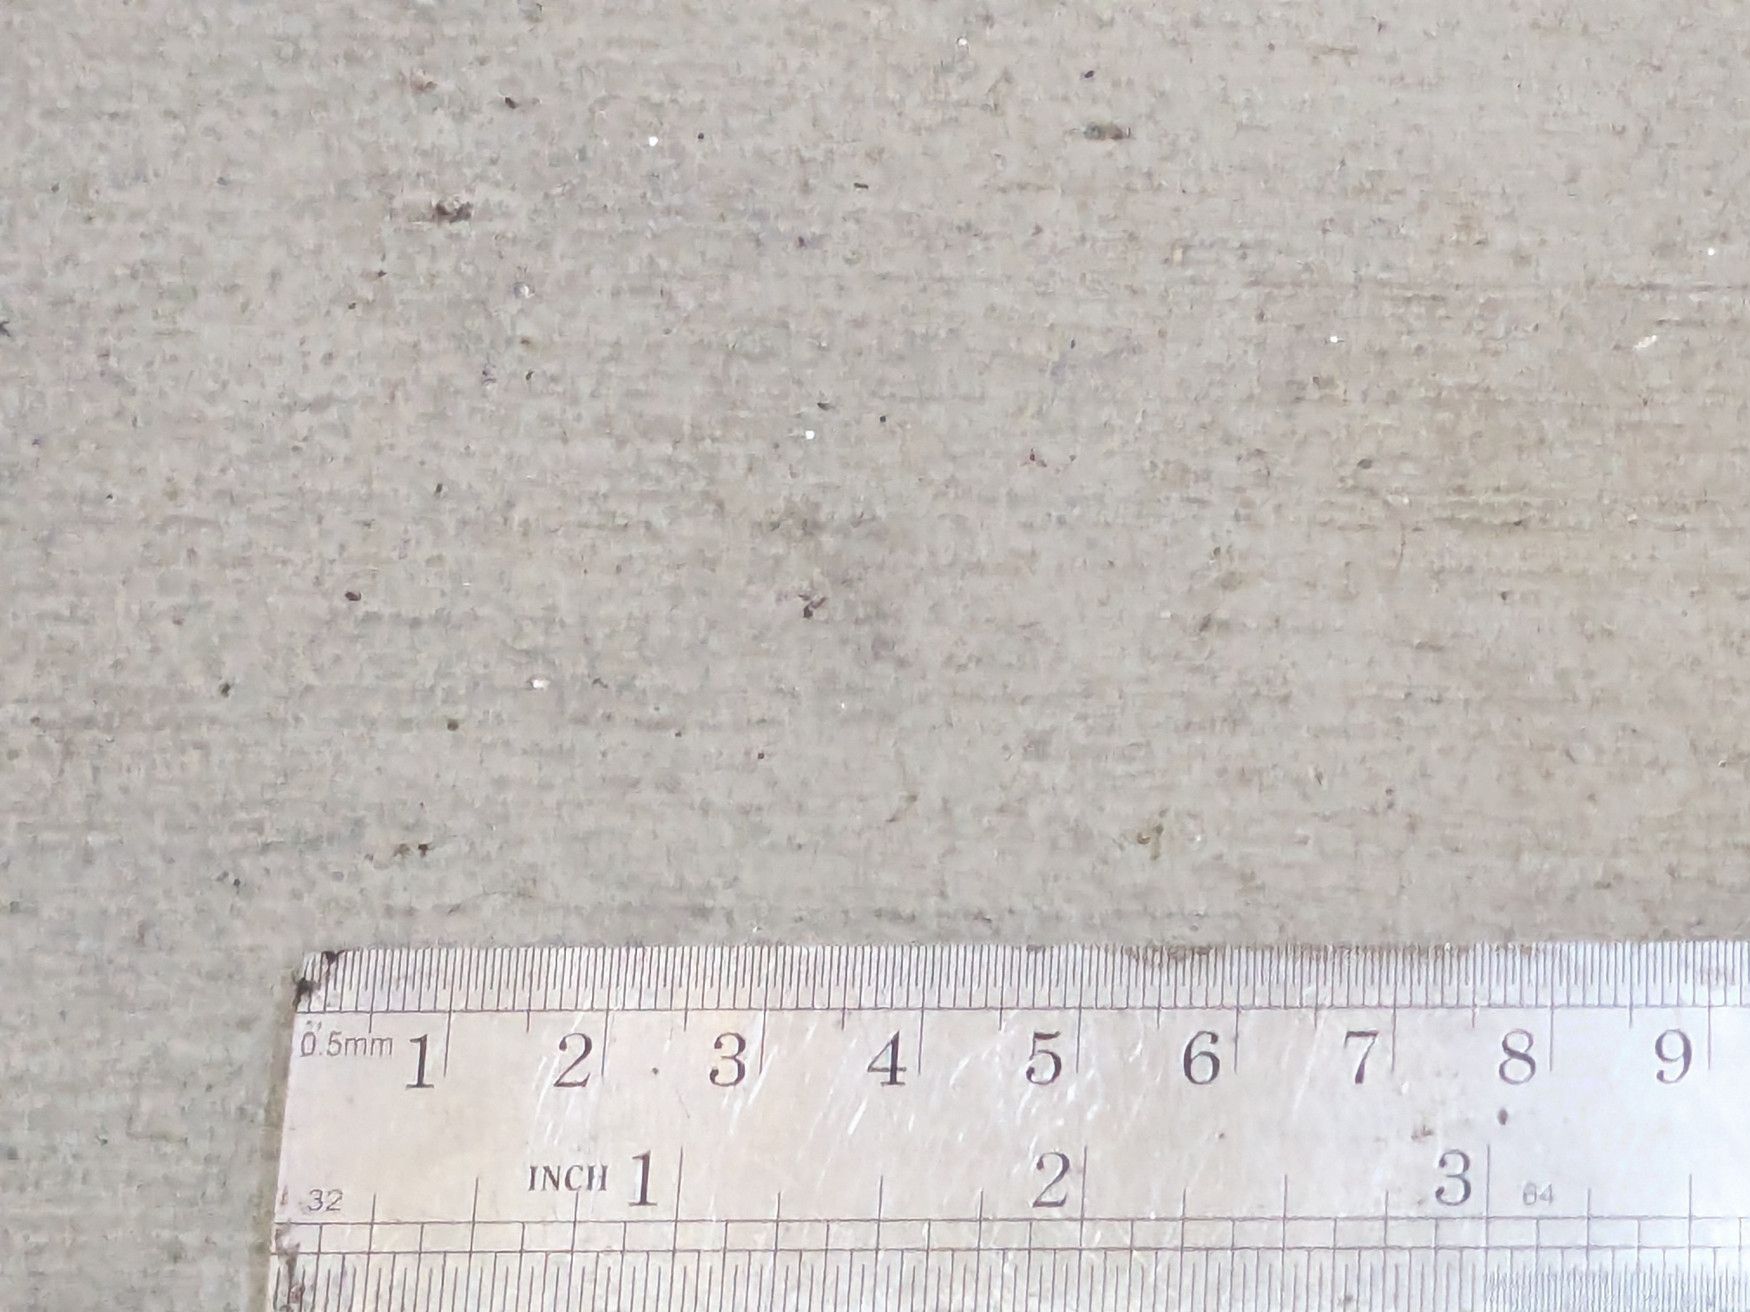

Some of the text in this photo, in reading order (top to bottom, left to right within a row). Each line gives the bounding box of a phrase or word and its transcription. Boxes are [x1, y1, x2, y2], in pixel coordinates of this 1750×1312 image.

[301, 1031, 393, 1057] 0.5mm
[405, 1034, 435, 1089] 1
[553, 1032, 594, 1088] 2
[709, 1032, 747, 1087] 3
[866, 1031, 907, 1086] 4
[1025, 1031, 1062, 1085] 5
[1182, 1031, 1221, 1085] 6
[1344, 1030, 1379, 1084] 7
[1498, 1029, 1537, 1085] 8
[1655, 1029, 1692, 1084] 9
[307, 1188, 343, 1212] 32
[527, 1150, 658, 1206] INCH 1
[1031, 1151, 1071, 1208] 2
[1435, 1149, 1471, 1206] 3
